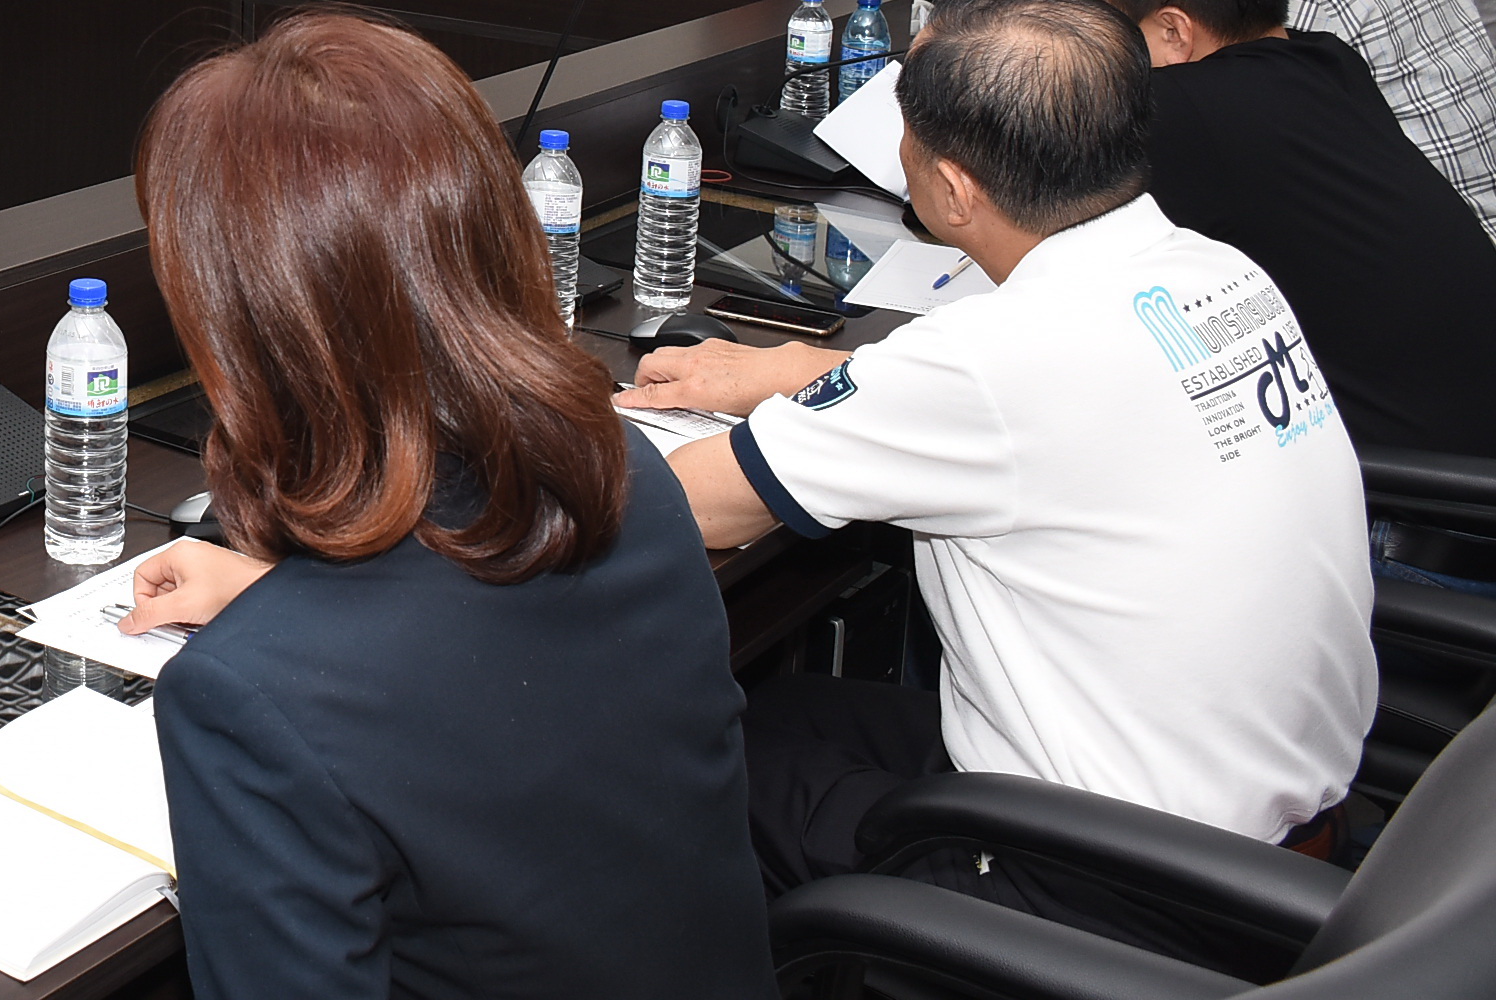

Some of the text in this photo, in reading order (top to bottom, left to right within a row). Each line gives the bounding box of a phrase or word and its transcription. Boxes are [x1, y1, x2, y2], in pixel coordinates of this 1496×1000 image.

[1181, 346, 1263, 394] ESTABLISHED
[1202, 402, 1245, 426] INNOVATION
[1207, 418, 1246, 438] LOOK ON
[1214, 425, 1263, 450] THE BRIGHT
[1275, 423, 1308, 448] Enjoy
[1308, 407, 1326, 429] life
[1219, 449, 1242, 463] SIDE
